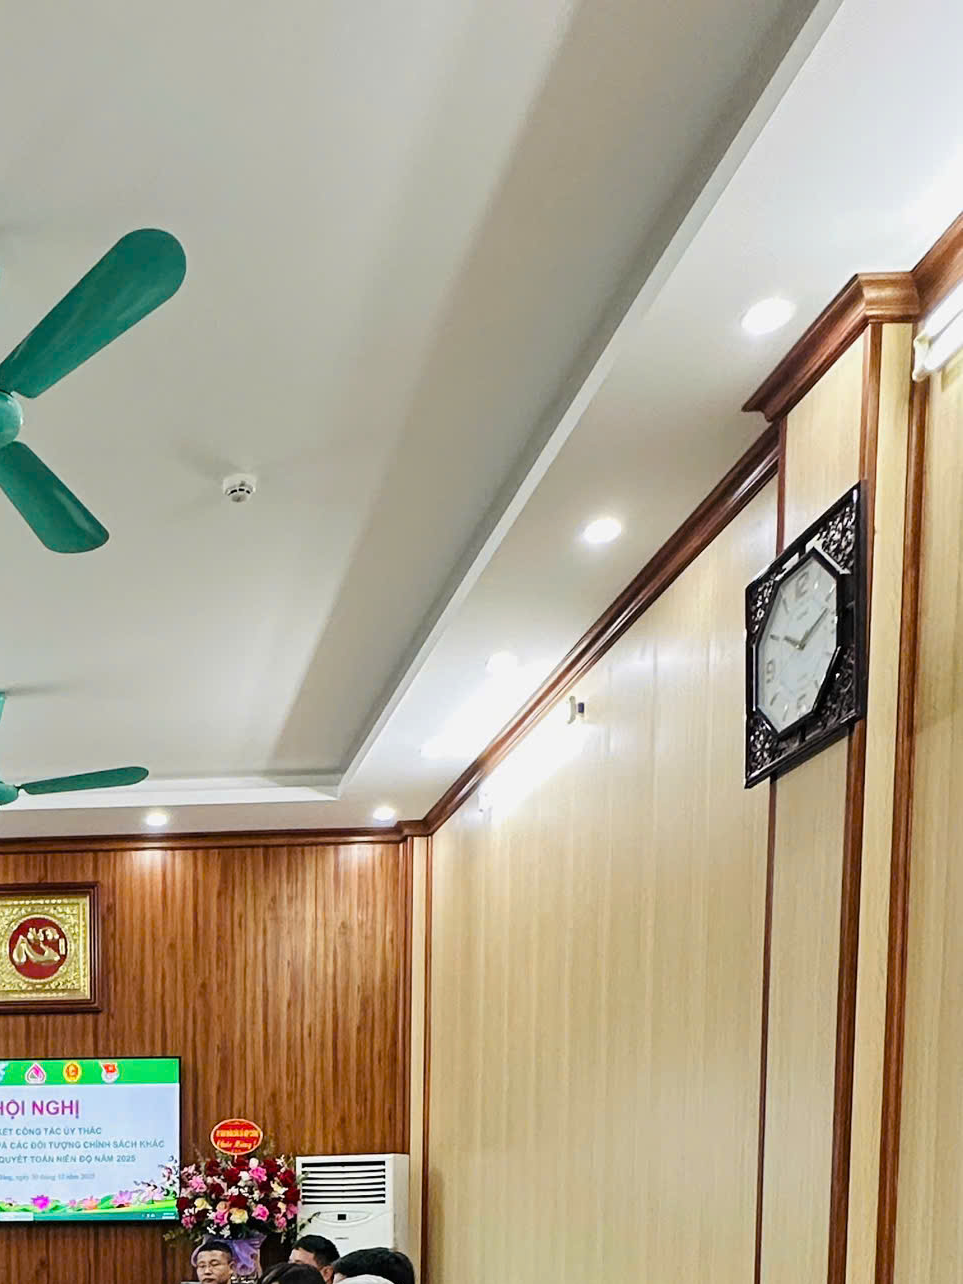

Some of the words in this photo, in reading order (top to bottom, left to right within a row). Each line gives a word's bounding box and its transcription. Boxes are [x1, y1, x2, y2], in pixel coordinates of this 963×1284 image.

[31, 1099, 79, 1119] NGHỊ
[15, 1126, 42, 1136] CÔNG
[44, 1126, 62, 1136] TÁC
[78, 1126, 102, 1135] THÁC
[10, 1140, 29, 1150] CÁC
[113, 1139, 137, 1149] SÁCH
[139, 1139, 165, 1148] KHÁC
[30, 1154, 54, 1163] TOÁN
[79, 1154, 93, 1164] ĐỘ
[94, 1153, 114, 1163] NĂM
[116, 1154, 136, 1163] 2025
